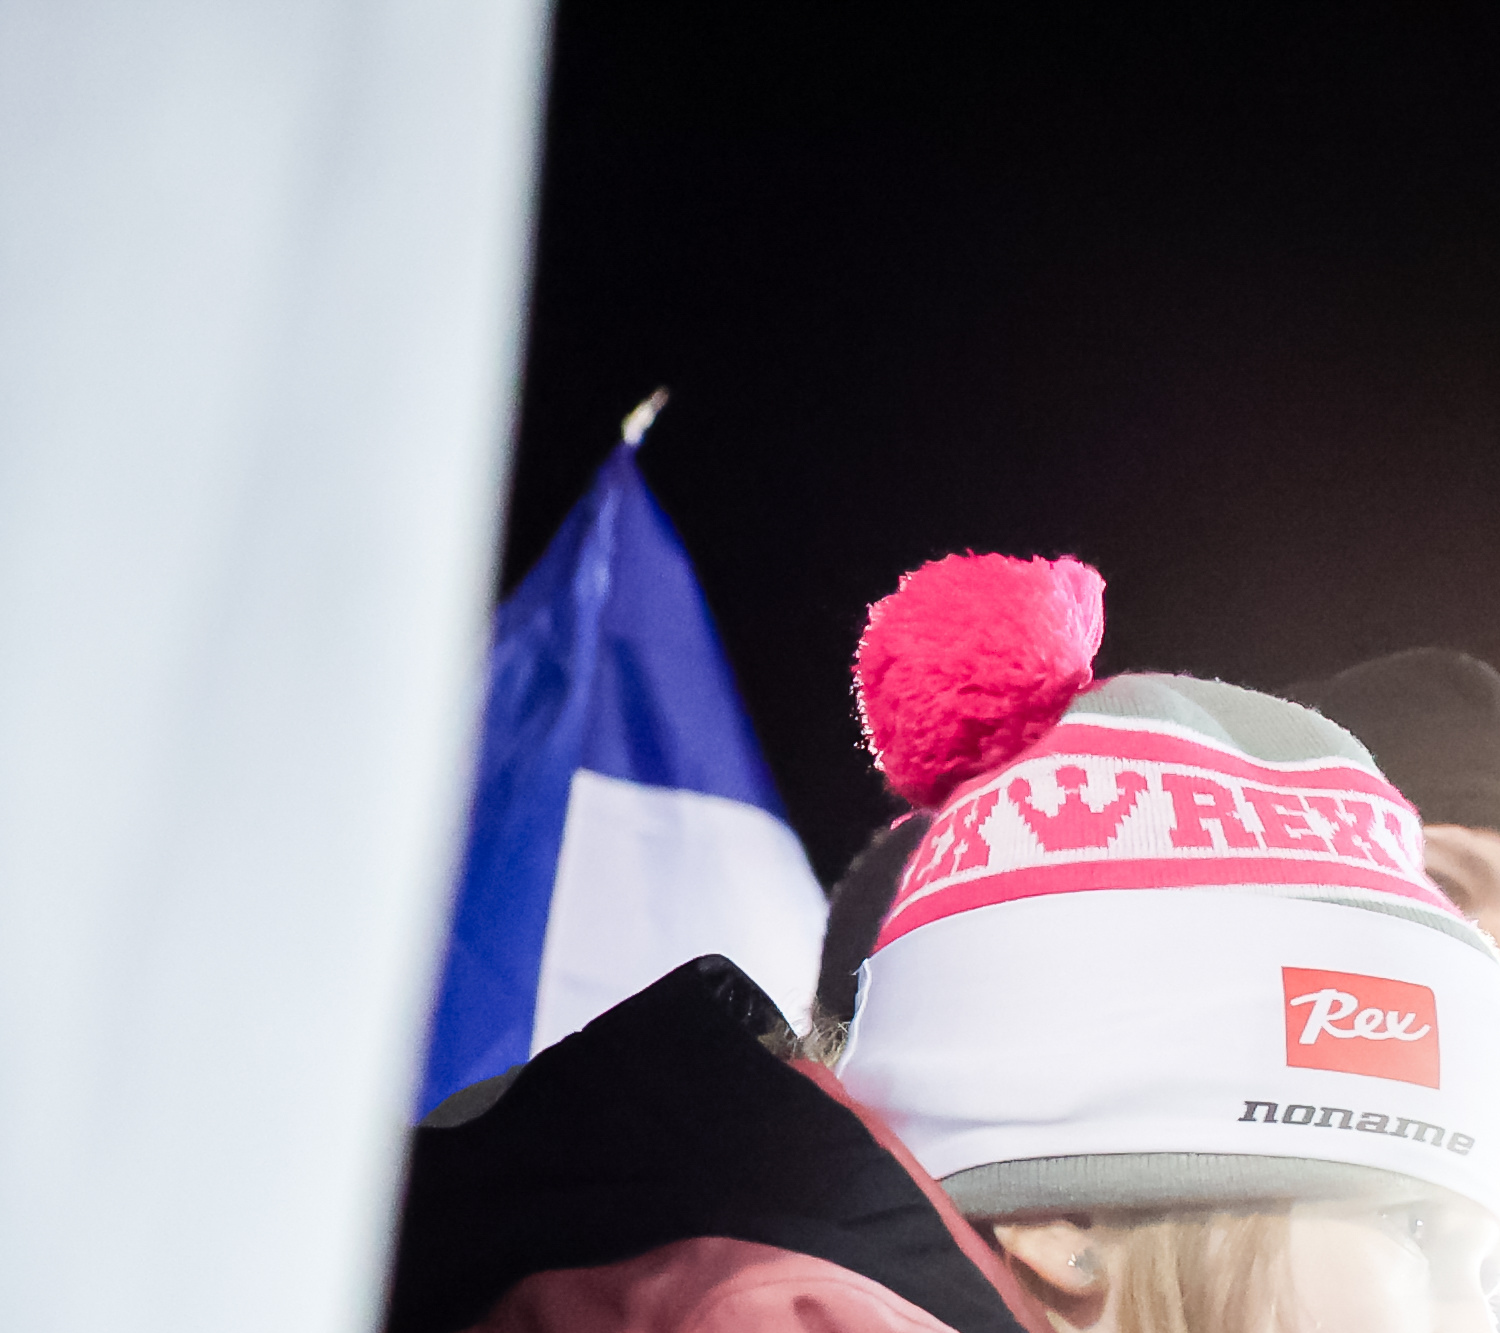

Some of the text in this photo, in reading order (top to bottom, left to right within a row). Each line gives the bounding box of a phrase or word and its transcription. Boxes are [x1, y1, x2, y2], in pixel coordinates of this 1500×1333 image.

[1160, 772, 1406, 872] REX
[1290, 987, 1432, 1047] Rex
[1237, 1099, 1476, 1158] noname
